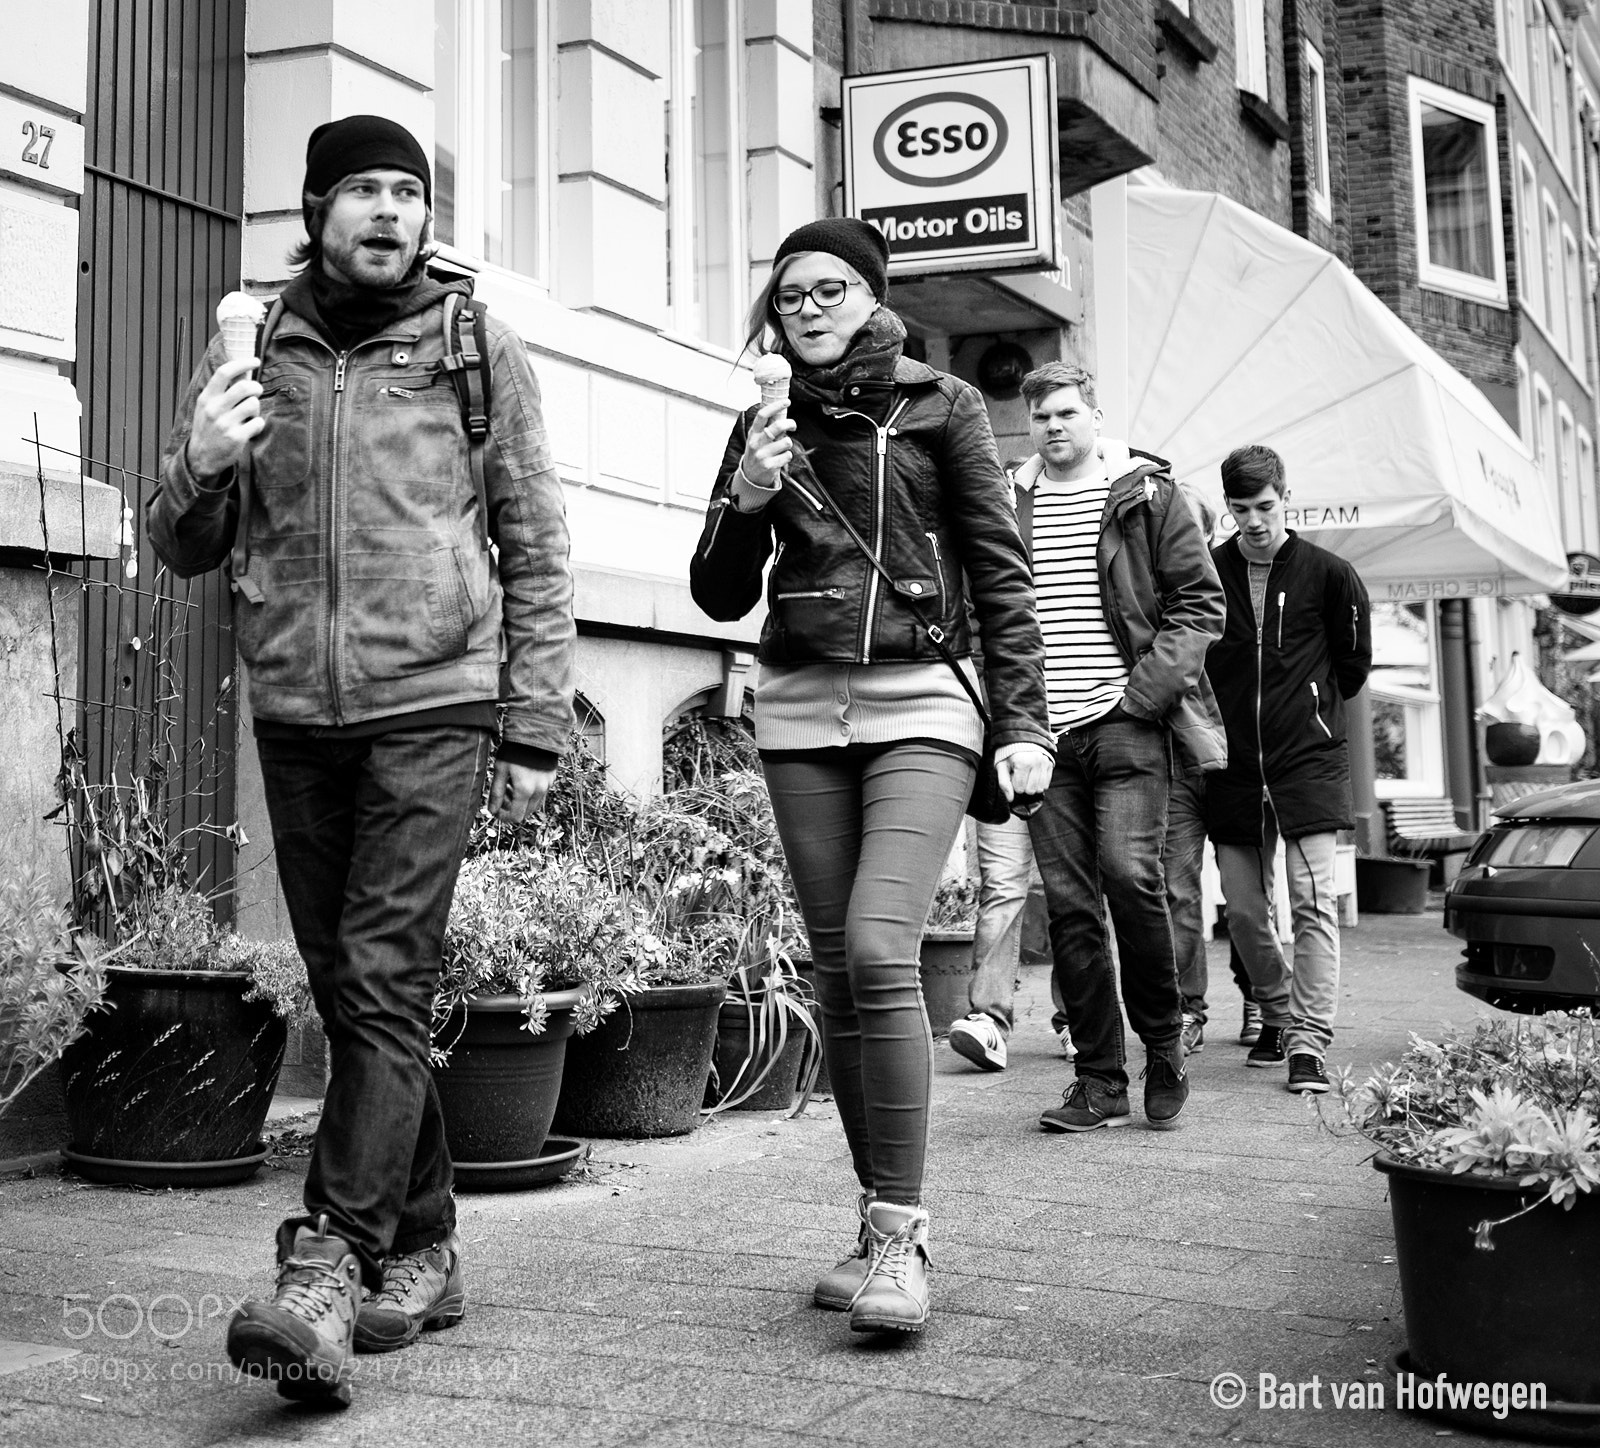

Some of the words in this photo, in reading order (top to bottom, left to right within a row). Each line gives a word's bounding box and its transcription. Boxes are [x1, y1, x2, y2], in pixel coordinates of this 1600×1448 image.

[22, 120, 56, 170] 27
[897, 120, 989, 158] Esso
[965, 205, 1023, 233] Oils
[1284, 506, 1360, 526] REAM
